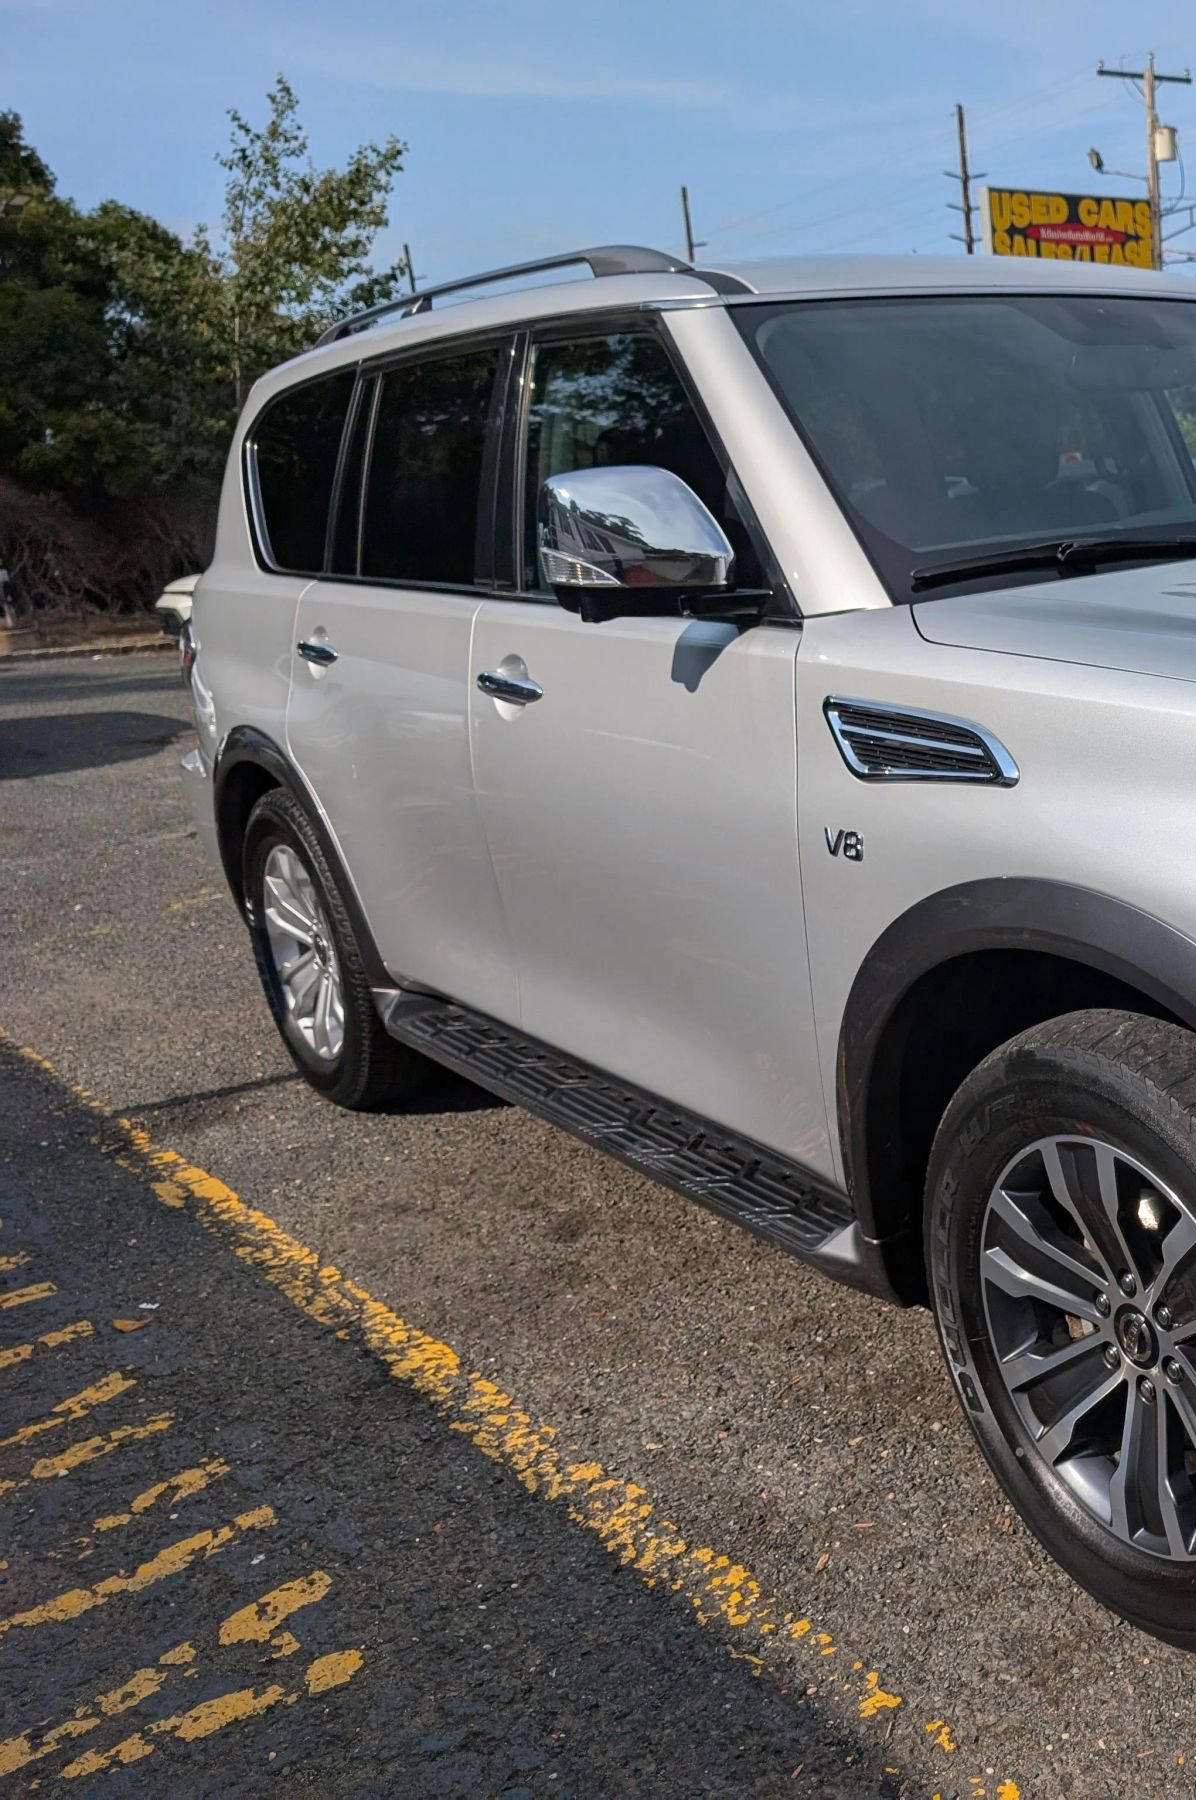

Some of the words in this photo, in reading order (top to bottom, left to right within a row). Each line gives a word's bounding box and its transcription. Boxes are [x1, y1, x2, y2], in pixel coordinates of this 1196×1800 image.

[991, 192, 1069, 231] USED
[1078, 198, 1152, 239] CARS
[824, 826, 864, 862] V8
